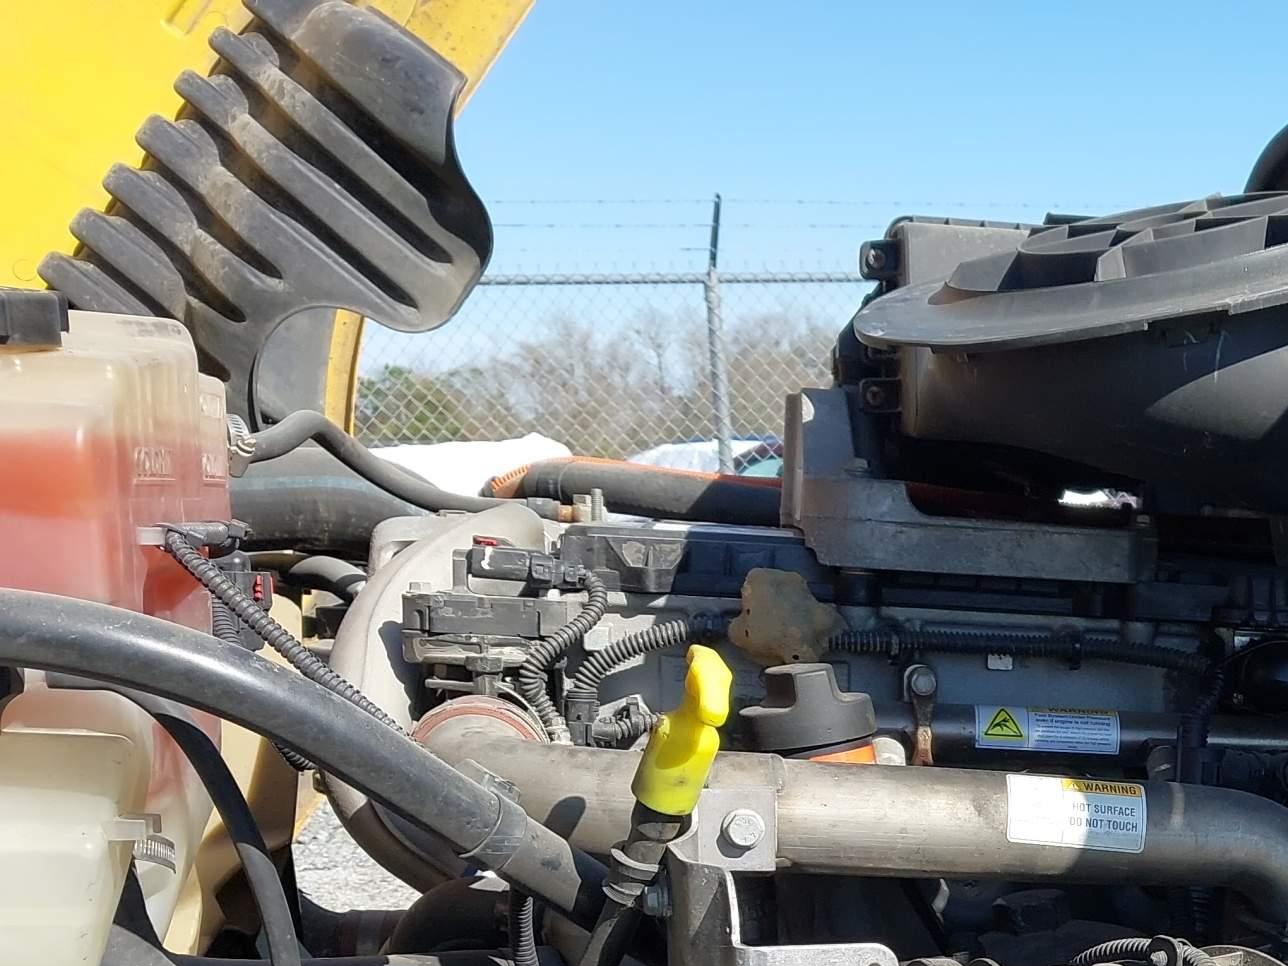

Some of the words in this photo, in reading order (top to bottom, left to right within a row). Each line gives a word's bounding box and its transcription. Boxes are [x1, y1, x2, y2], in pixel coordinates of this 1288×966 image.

[1084, 782, 1138, 795] WARNING
[1072, 802, 1092, 813] HOT
[1094, 803, 1136, 817] SURFACE
[1069, 817, 1083, 826] DO
[1085, 817, 1105, 830] NOT
[1107, 818, 1138, 832] TOUCH
